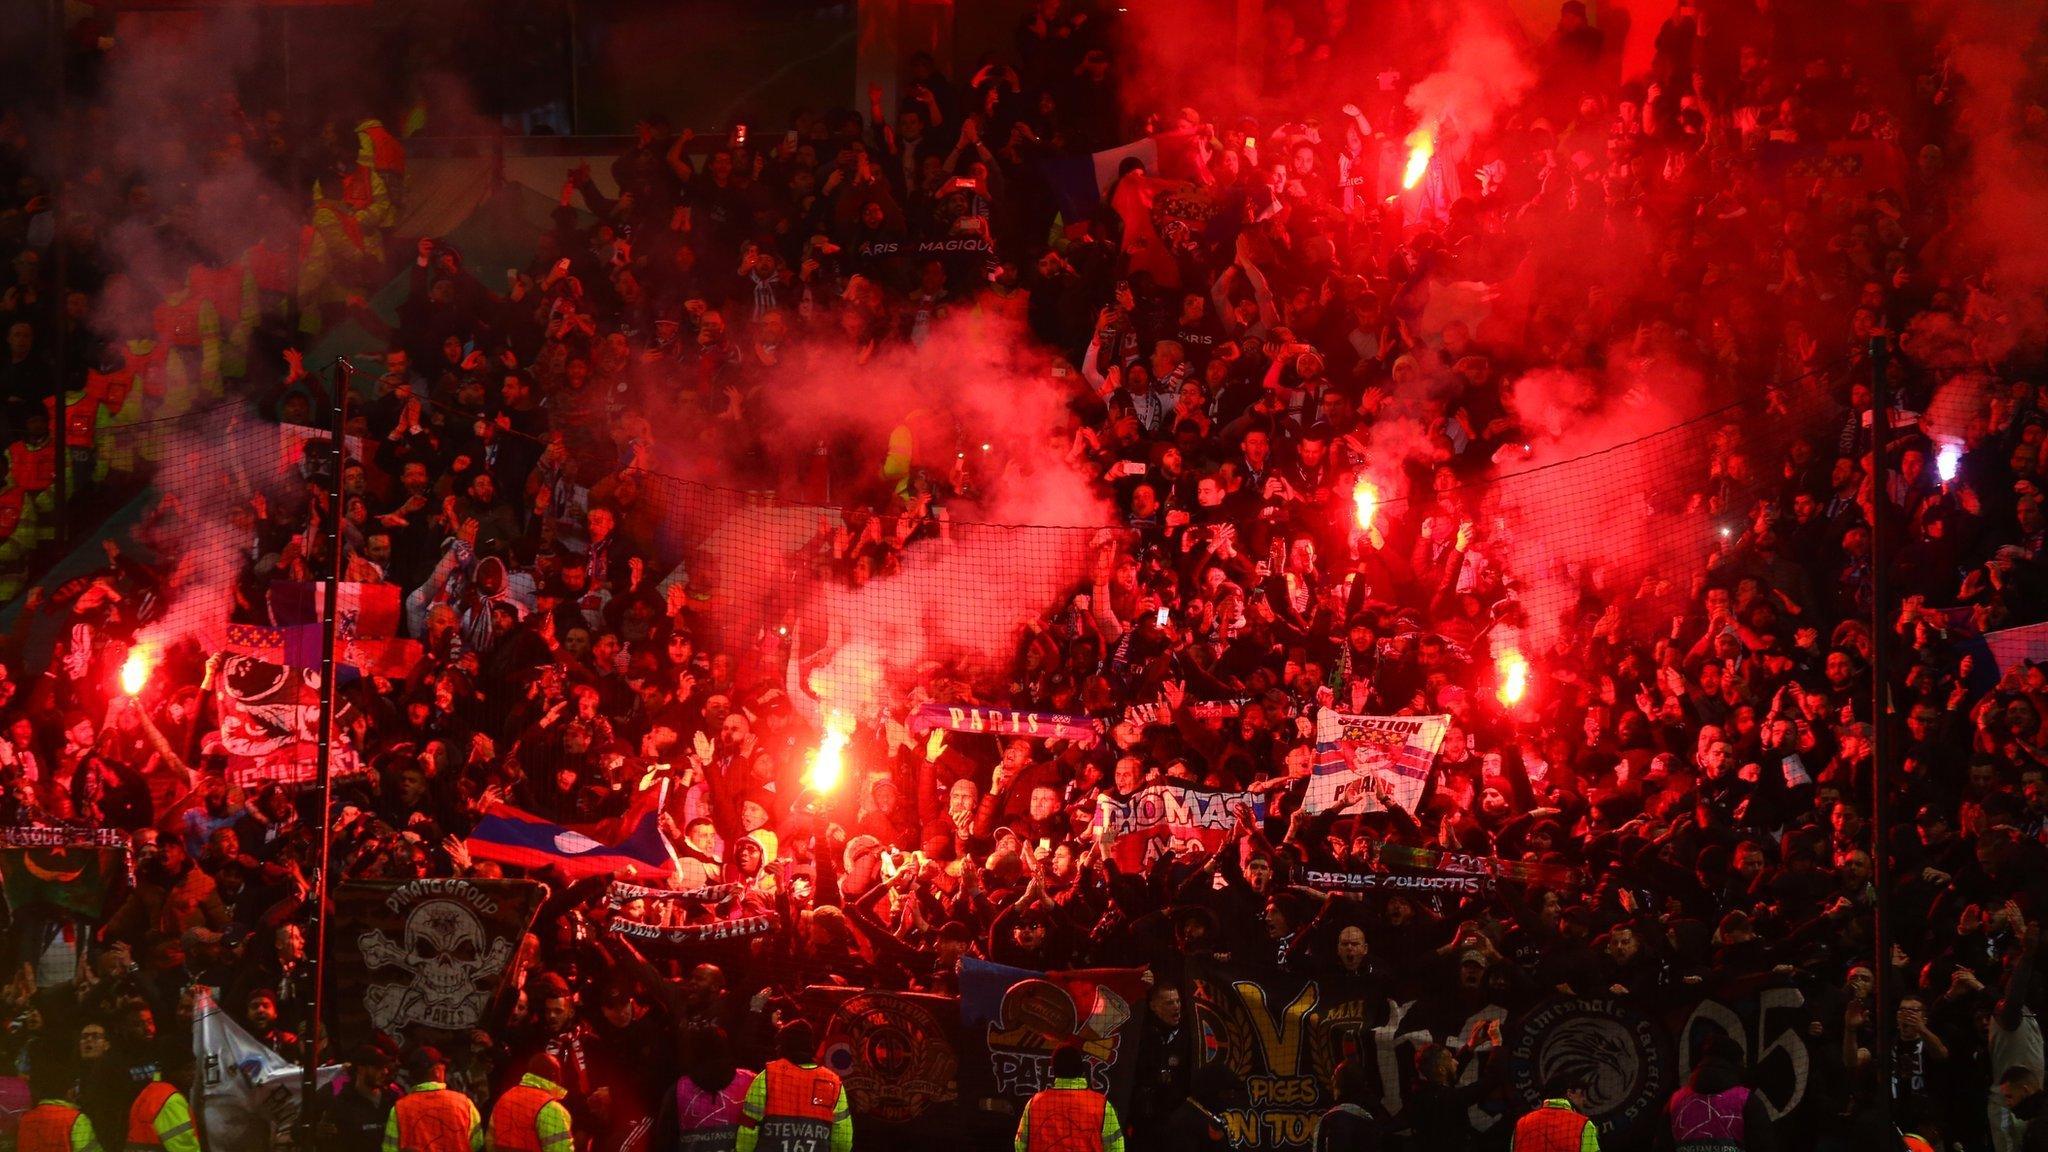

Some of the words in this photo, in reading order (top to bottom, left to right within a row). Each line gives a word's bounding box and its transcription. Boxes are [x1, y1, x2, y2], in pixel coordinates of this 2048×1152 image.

[919, 239, 990, 253] MAGIQU
[949, 707, 1039, 733] PARIS
[1338, 717, 1423, 735] SECTION
[445, 878, 499, 914] GROUP
[424, 1005, 465, 1025] PARIS
[991, 1052, 1111, 1097] PAS
[1250, 1078, 1317, 1104] PIGES
[764, 1122, 830, 1140] STEWARD
